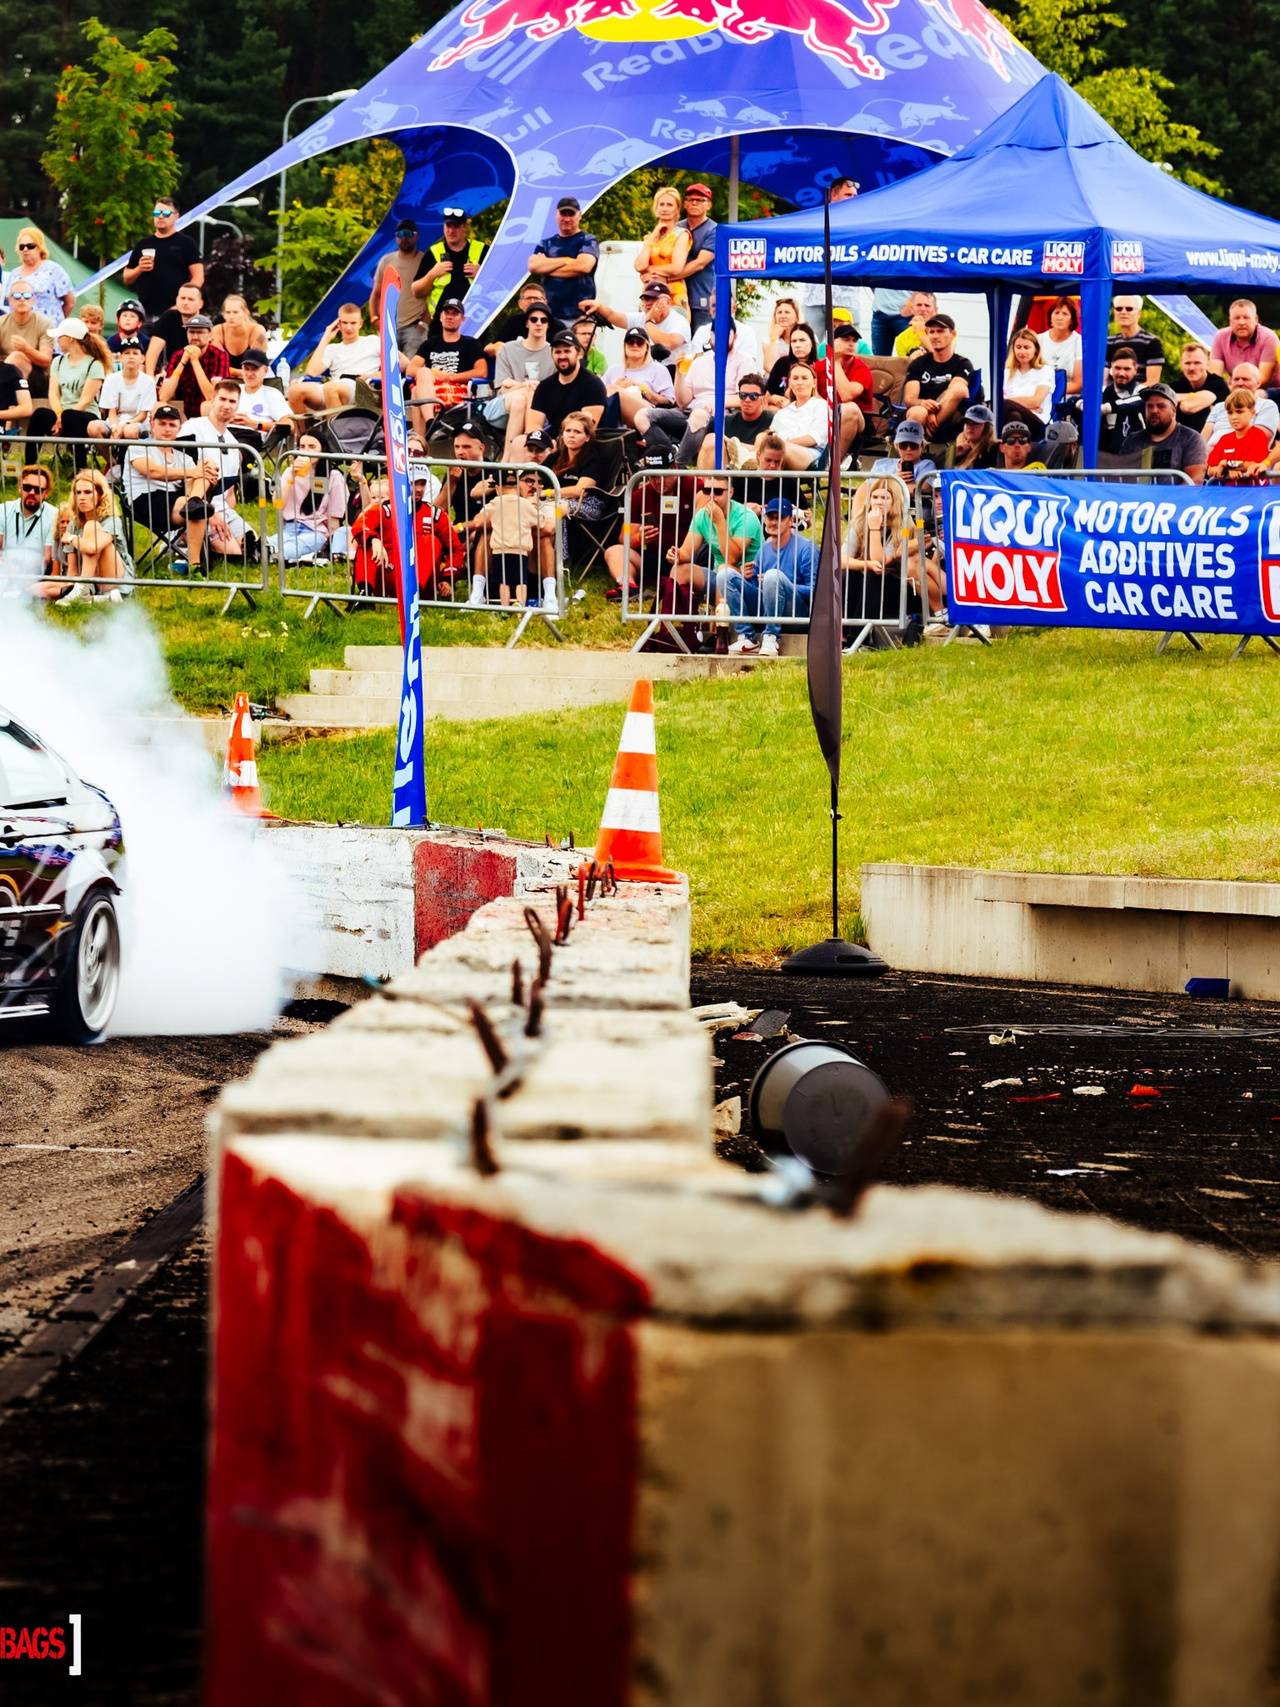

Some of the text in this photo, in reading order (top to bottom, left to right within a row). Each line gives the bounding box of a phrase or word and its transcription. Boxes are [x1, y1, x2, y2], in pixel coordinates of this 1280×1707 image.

[581, 40, 687, 91] Red
[502, 106, 553, 142] ull
[730, 240, 766, 255] LIQUI
[774, 246, 824, 264] MOTOR
[867, 245, 948, 263] ADDITIVES
[957, 246, 989, 265] CAR
[991, 249, 1033, 266] CARE
[1045, 243, 1083, 258] LIQUI
[1113, 243, 1141, 257] LIQUI
[730, 255, 766, 270] MOLY
[1043, 257, 1083, 273] MOLY
[1112, 257, 1143, 272] MOLY
[955, 489, 1060, 547] LIQUI
[1073, 500, 1177, 535] MOTOR
[1177, 505, 1254, 536] OILS
[1079, 540, 1236, 579] ADDITIVES
[957, 547, 1057, 604] MOLY
[1085, 581, 1150, 616] CAR
[1150, 583, 1238, 620] CARE
